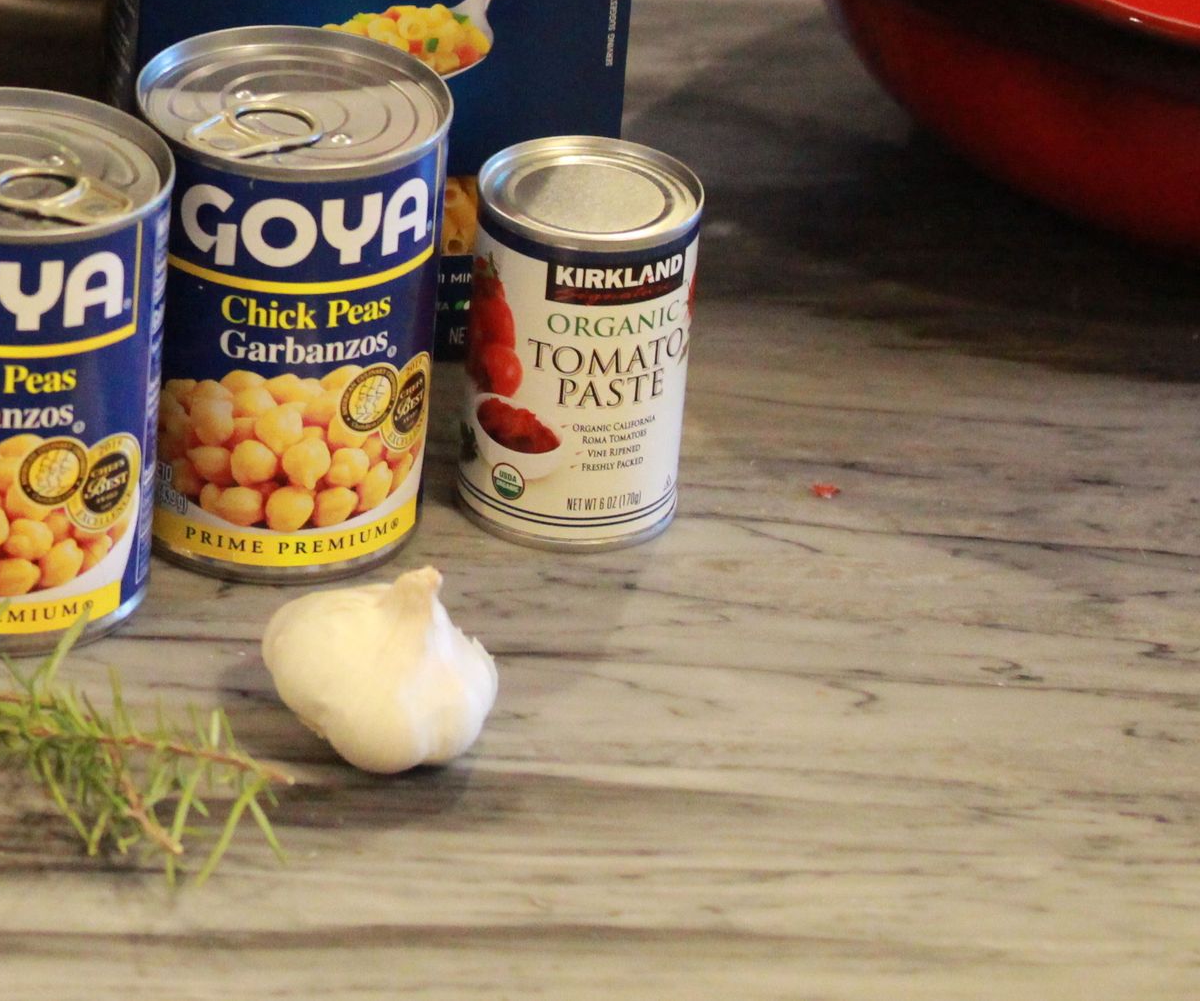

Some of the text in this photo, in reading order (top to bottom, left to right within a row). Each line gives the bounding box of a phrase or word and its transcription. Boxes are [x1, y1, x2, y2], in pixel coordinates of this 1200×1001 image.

[181, 177, 430, 267] GOYA
[555, 253, 684, 289] KIRKLAND
[220, 294, 392, 330] Chick Peas
[547, 300, 680, 337] ORGANIC
[220, 329, 389, 365] Garbanzos
[528, 327, 683, 376] TOMATO
[2, 364, 77, 394] Peas
[557, 368, 664, 409] PASTE
[572, 414, 656, 433] ORGANIC CALIFORNIA
[582, 429, 647, 445] ROMA TOMATOES
[581, 456, 644, 472] FRESHLY PACKED
[587, 444, 641, 458] VINE RIPENED
[498, 469, 517, 484] USDA
[567, 490, 642, 511] NET WT 6 OZ (170g)
[185, 522, 389, 554] PRIME PREMIUM
